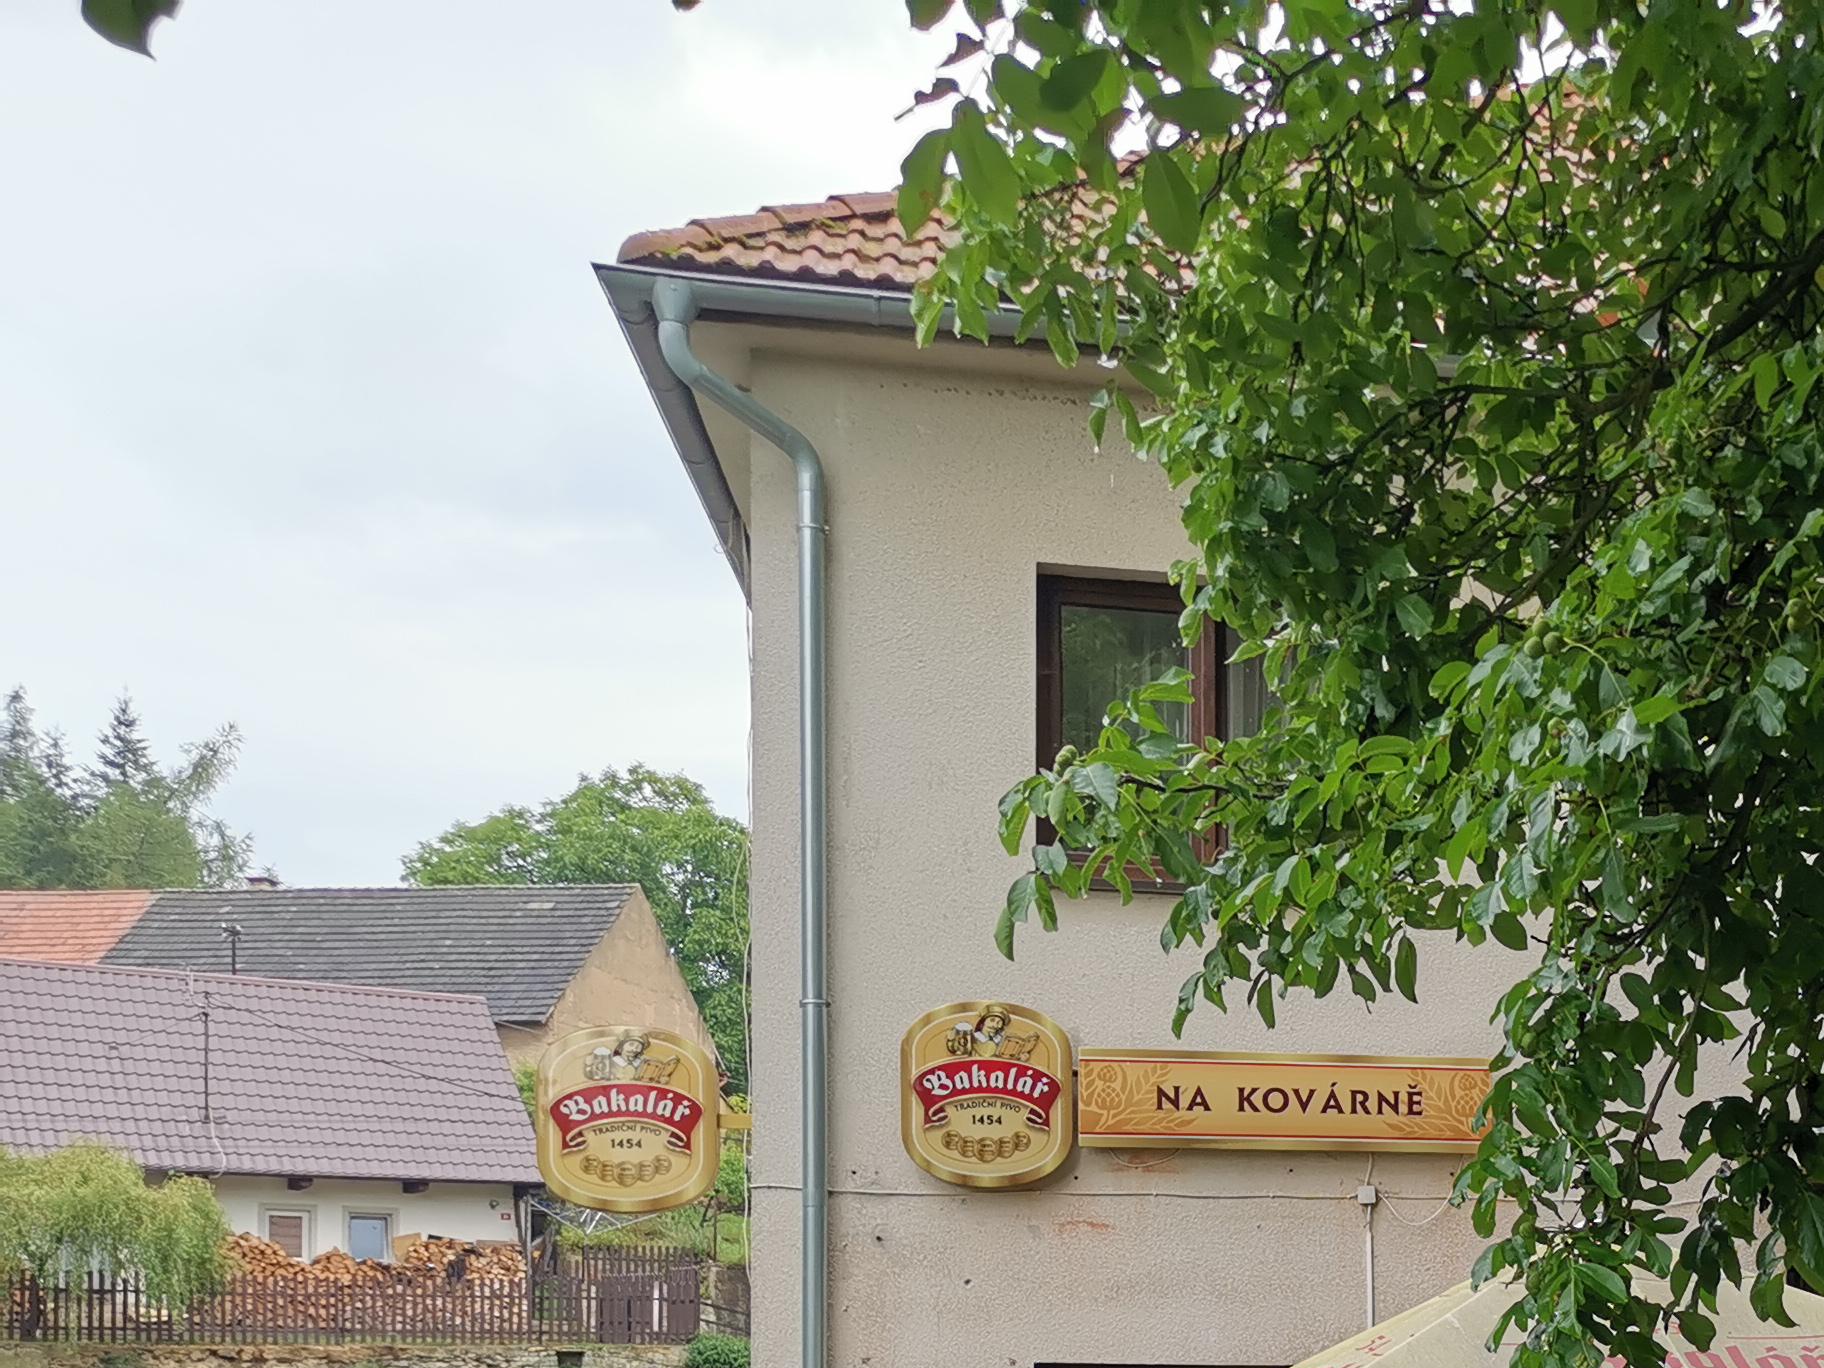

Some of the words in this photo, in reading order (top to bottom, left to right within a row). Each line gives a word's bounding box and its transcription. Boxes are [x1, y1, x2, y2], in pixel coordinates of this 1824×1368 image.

[922, 1063, 1051, 1099] Bakalář
[559, 1088, 692, 1122] Bakalář
[953, 1099, 998, 1113] TRADIČNÍ
[999, 1102, 1022, 1114] PIVO
[1155, 1085, 1213, 1113] NA
[1236, 1082, 1424, 1117] KOVÁRNĚ
[971, 1114, 1003, 1126] 1454
[592, 1122, 638, 1137] TRADIČNÍ
[639, 1122, 662, 1137] PIVO
[610, 1138, 643, 1150] 1454
